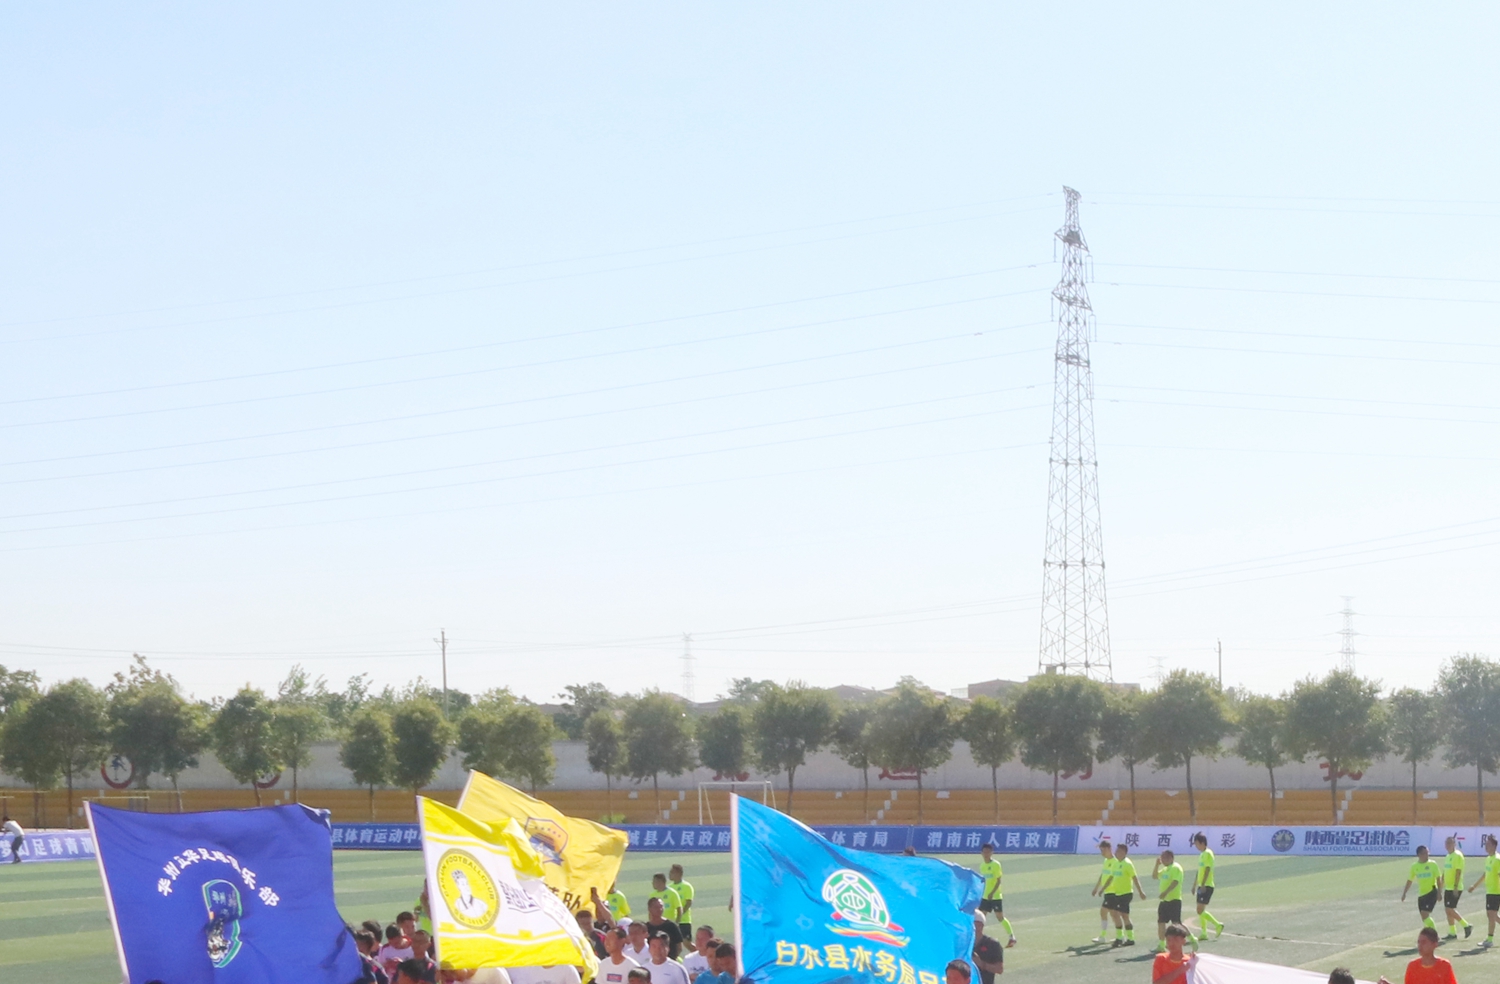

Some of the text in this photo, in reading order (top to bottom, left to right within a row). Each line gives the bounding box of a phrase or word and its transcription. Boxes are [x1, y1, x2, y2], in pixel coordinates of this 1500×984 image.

[331, 828, 424, 843] 县体育运动中
[817, 831, 888, 847] 体育局
[927, 831, 1061, 848] 渭南市人民政府
[1304, 830, 1411, 845] 陕西省足球协会
